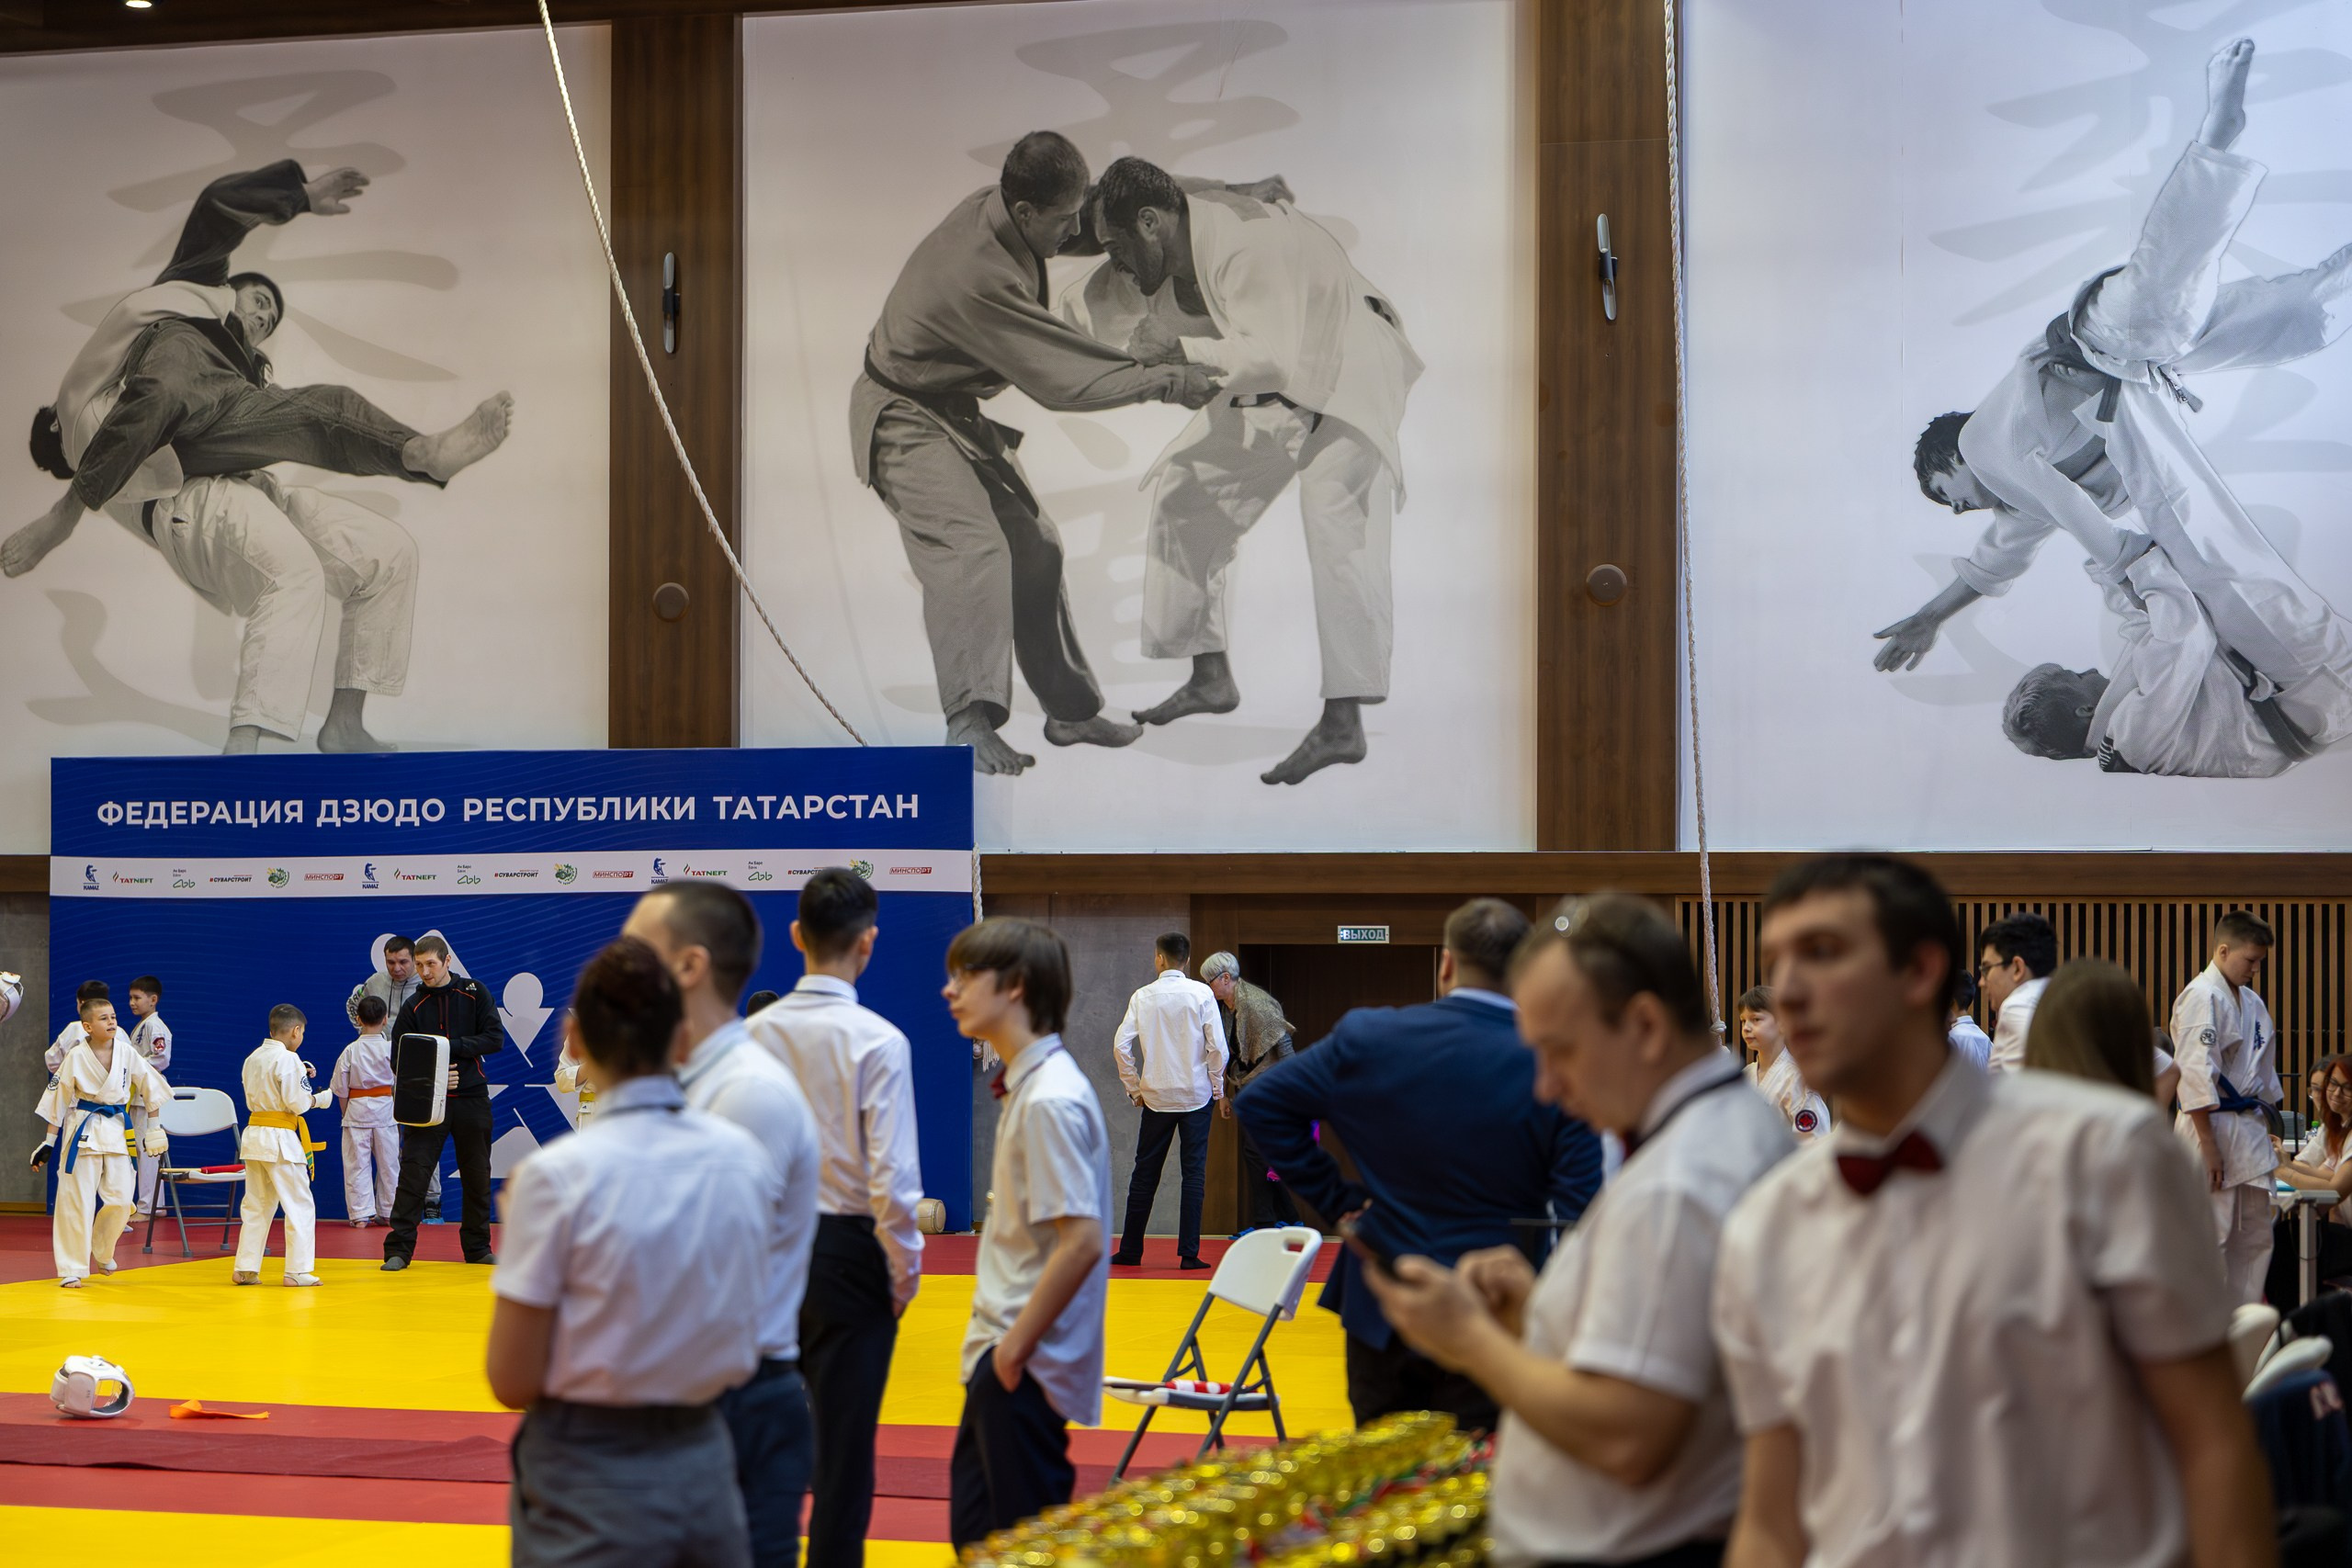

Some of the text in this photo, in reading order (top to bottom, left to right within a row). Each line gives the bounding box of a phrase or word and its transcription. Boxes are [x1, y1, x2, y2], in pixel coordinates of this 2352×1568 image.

[96, 794, 919, 829] ФЕДЕРАЦИЯ ДЗЮДО РЕСПУБЛИКИ ТАТАРСТАН
[1343, 929, 1385, 941] ВЫХОД
